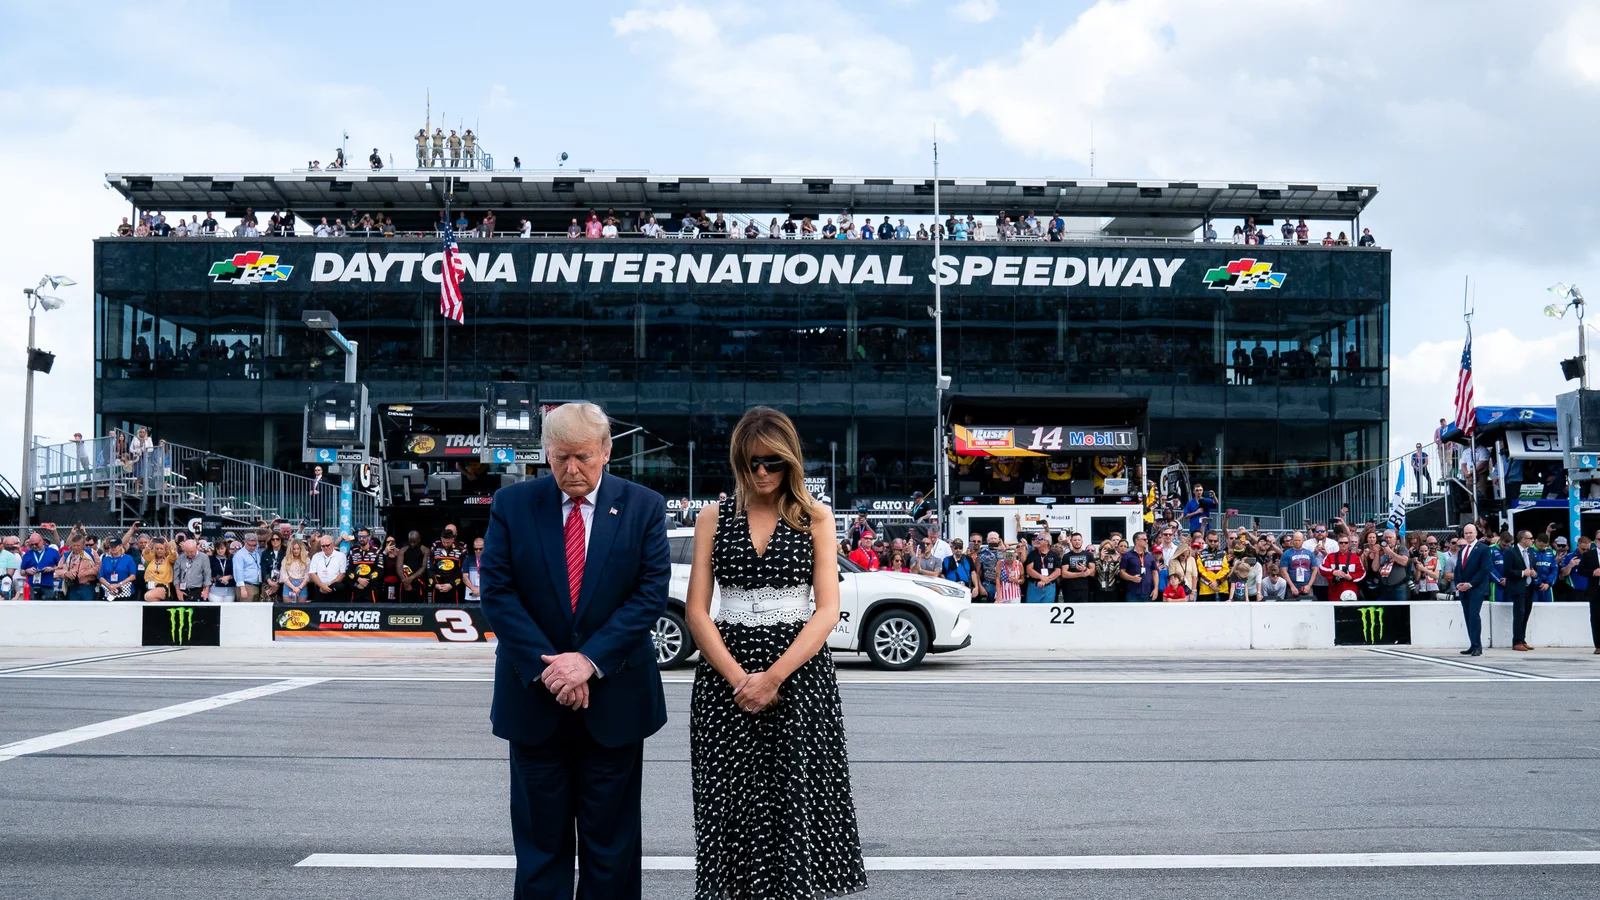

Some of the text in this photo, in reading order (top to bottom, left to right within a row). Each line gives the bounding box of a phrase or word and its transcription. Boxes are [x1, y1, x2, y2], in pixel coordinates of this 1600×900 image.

[310, 252, 1186, 288] DAYTONA INTERNATIONAL SPEEDWAY
[1028, 427, 1063, 450] 14
[1069, 431, 1113, 446] Mobil
[319, 610, 381, 623] TRACKER
[1050, 606, 1075, 624] 22
[434, 609, 479, 642] 3
